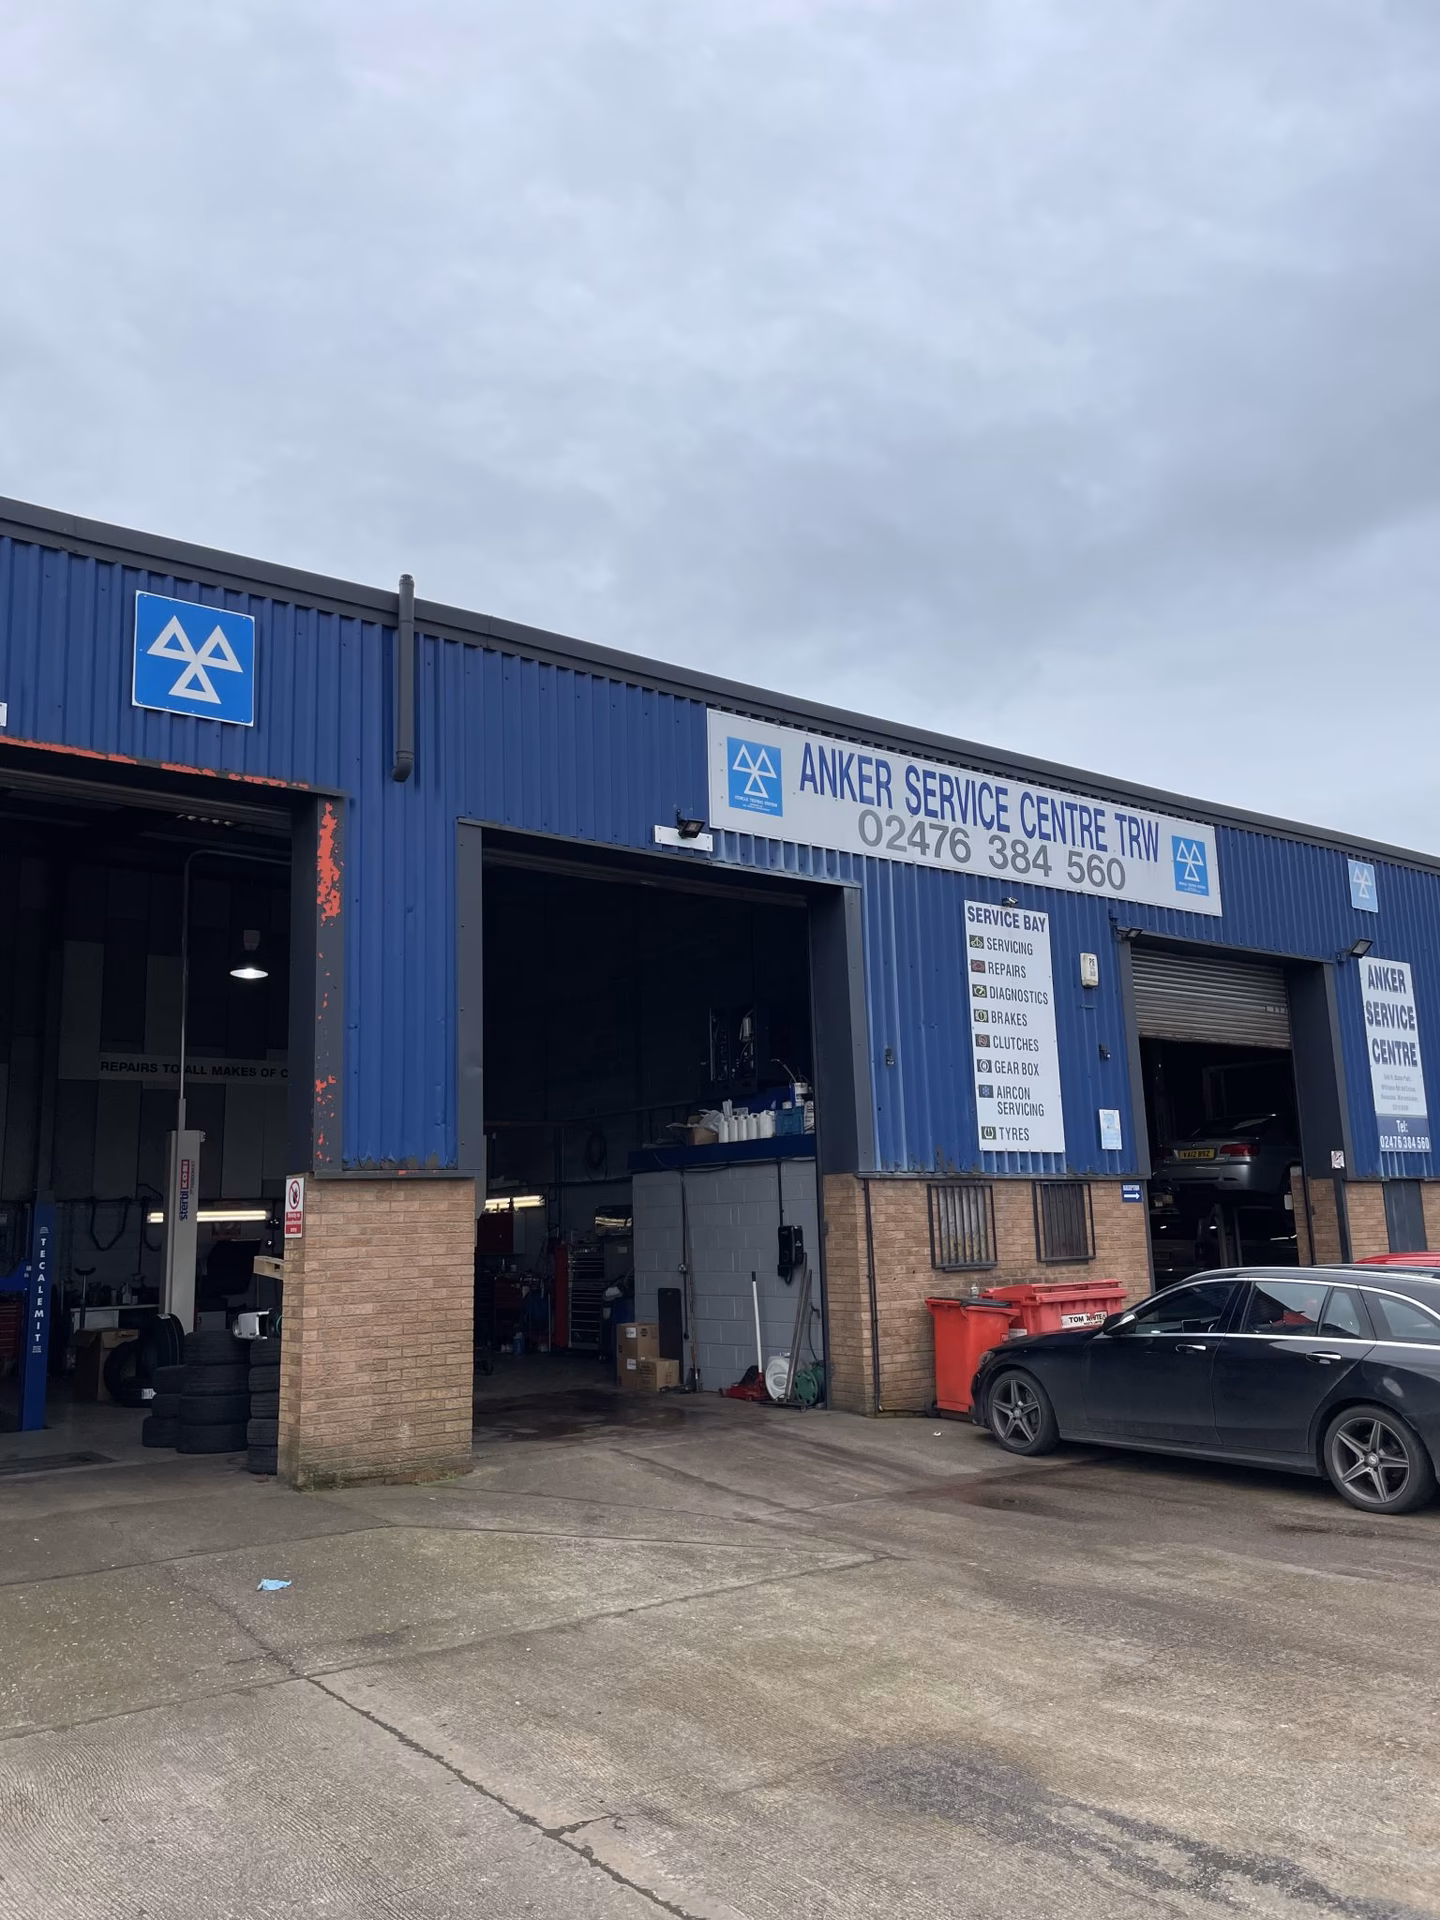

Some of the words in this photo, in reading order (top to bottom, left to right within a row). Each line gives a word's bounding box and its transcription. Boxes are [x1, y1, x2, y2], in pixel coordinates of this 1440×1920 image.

[800, 742, 893, 809] ANKER
[905, 765, 1010, 833] SERVICE
[1020, 791, 1108, 852] CENTRE
[1115, 813, 1159, 862] TRW
[858, 809, 971, 863] 02476
[988, 835, 1052, 877] 384
[1067, 850, 1125, 890] 560
[967, 905, 1020, 929] SERVICE
[1023, 916, 1046, 933] BAY
[986, 937, 1033, 956] SERVICING
[988, 961, 1027, 979] REPAIRS
[1368, 964, 1406, 994] ANKER
[989, 986, 1049, 1005] DIAGNOSTICS
[991, 1010, 1028, 1027] BRAKES
[1365, 1000, 1415, 1031] SERVICE
[993, 1035, 1039, 1052] CLUTCHES
[1371, 1038, 1418, 1068] CENTRE
[100, 1061, 158, 1073] REPAIRS
[162, 1064, 180, 1074] TO
[184, 1065, 207, 1075] ALL
[211, 1066, 256, 1077] MAKES
[260, 1068, 277, 1078] OF
[994, 1060, 1020, 1076] GEAR
[1022, 1061, 1040, 1077] BOX
[996, 1085, 1031, 1101] AIRCON
[997, 1101, 1045, 1117] SERVICING
[998, 1126, 1030, 1141] TYRES
[1396, 1120, 1409, 1133] Tel:
[1380, 1135, 1402, 1148] 02476
[1403, 1136, 1416, 1149] 384
[1417, 1136, 1430, 1149] 560
[34, 1238, 47, 1342] TECALEMIT
[1068, 1316, 1085, 1324] TOM
